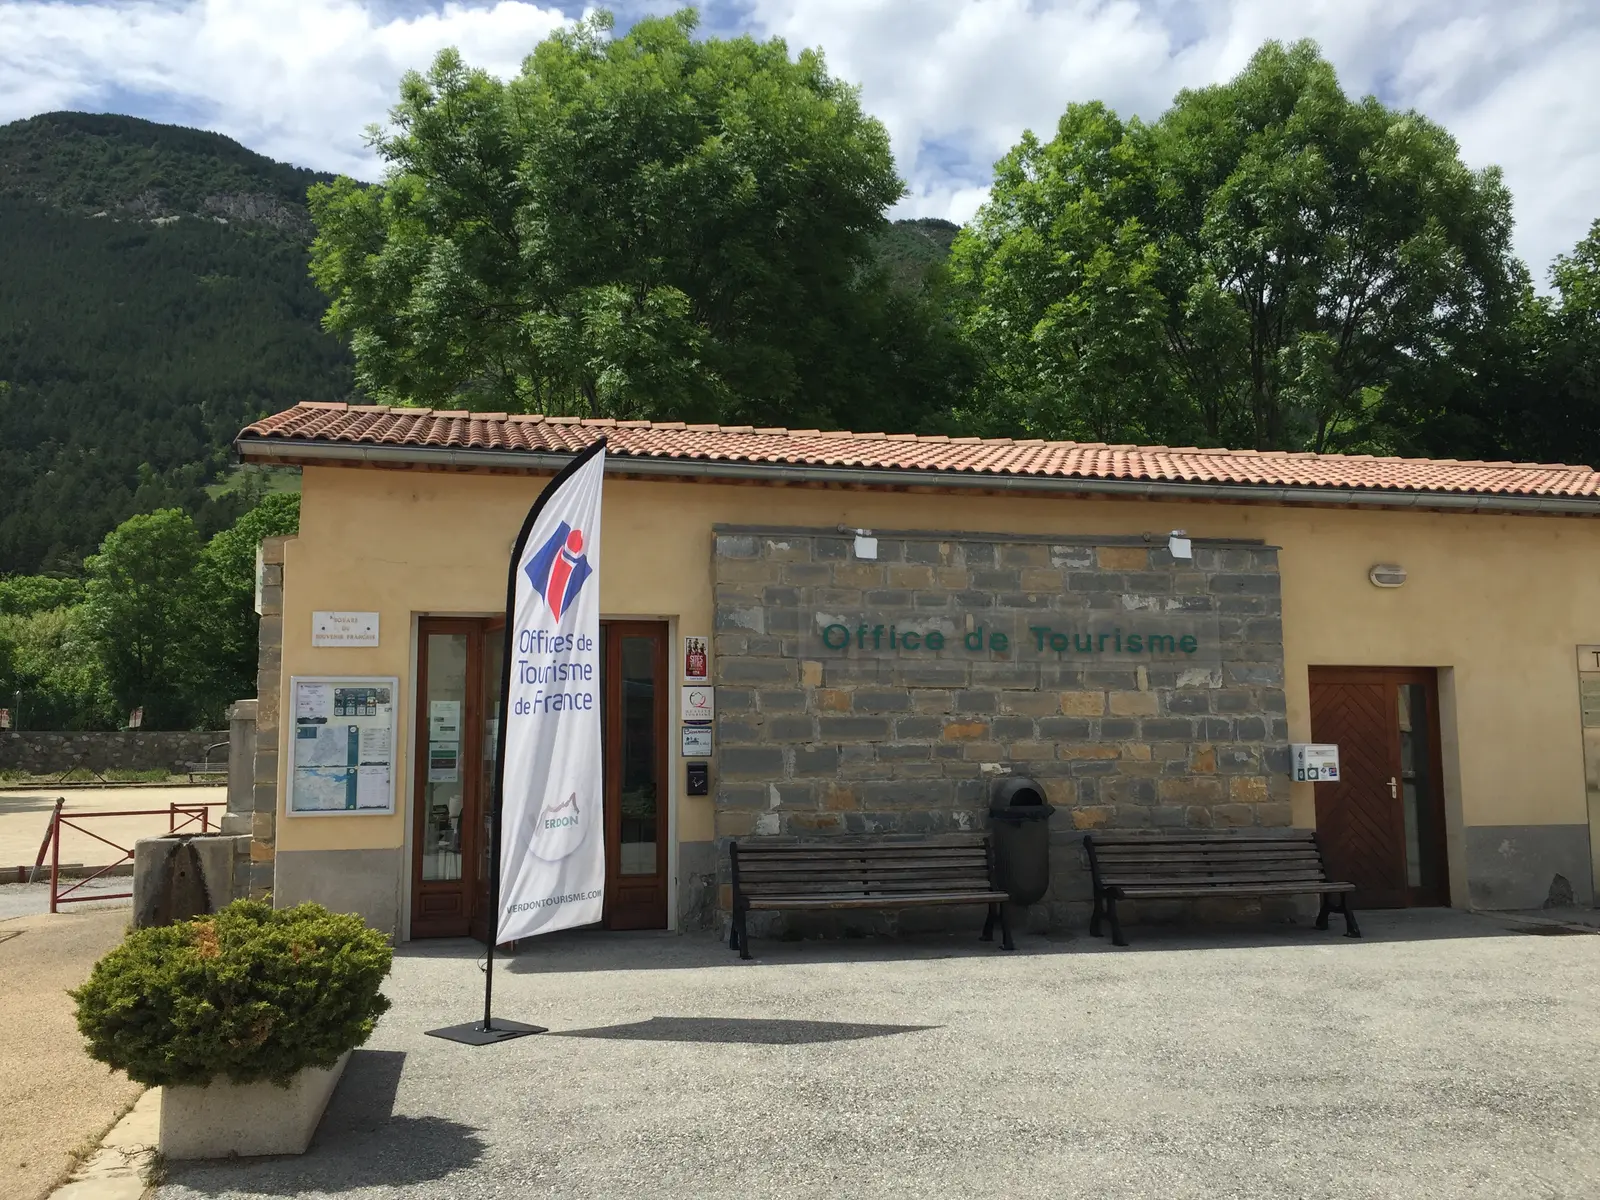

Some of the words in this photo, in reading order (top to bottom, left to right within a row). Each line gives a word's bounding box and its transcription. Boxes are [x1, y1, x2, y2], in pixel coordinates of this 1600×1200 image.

[519, 629, 574, 654] Offices
[577, 634, 593, 651] de
[821, 622, 945, 651] Office
[964, 626, 1009, 652] de
[1030, 626, 1198, 653] Tourisme
[518, 660, 592, 684] Tourisme
[514, 697, 531, 715] de
[533, 690, 592, 714] France
[507, 889, 602, 914] VERDONTOURISME.COM
